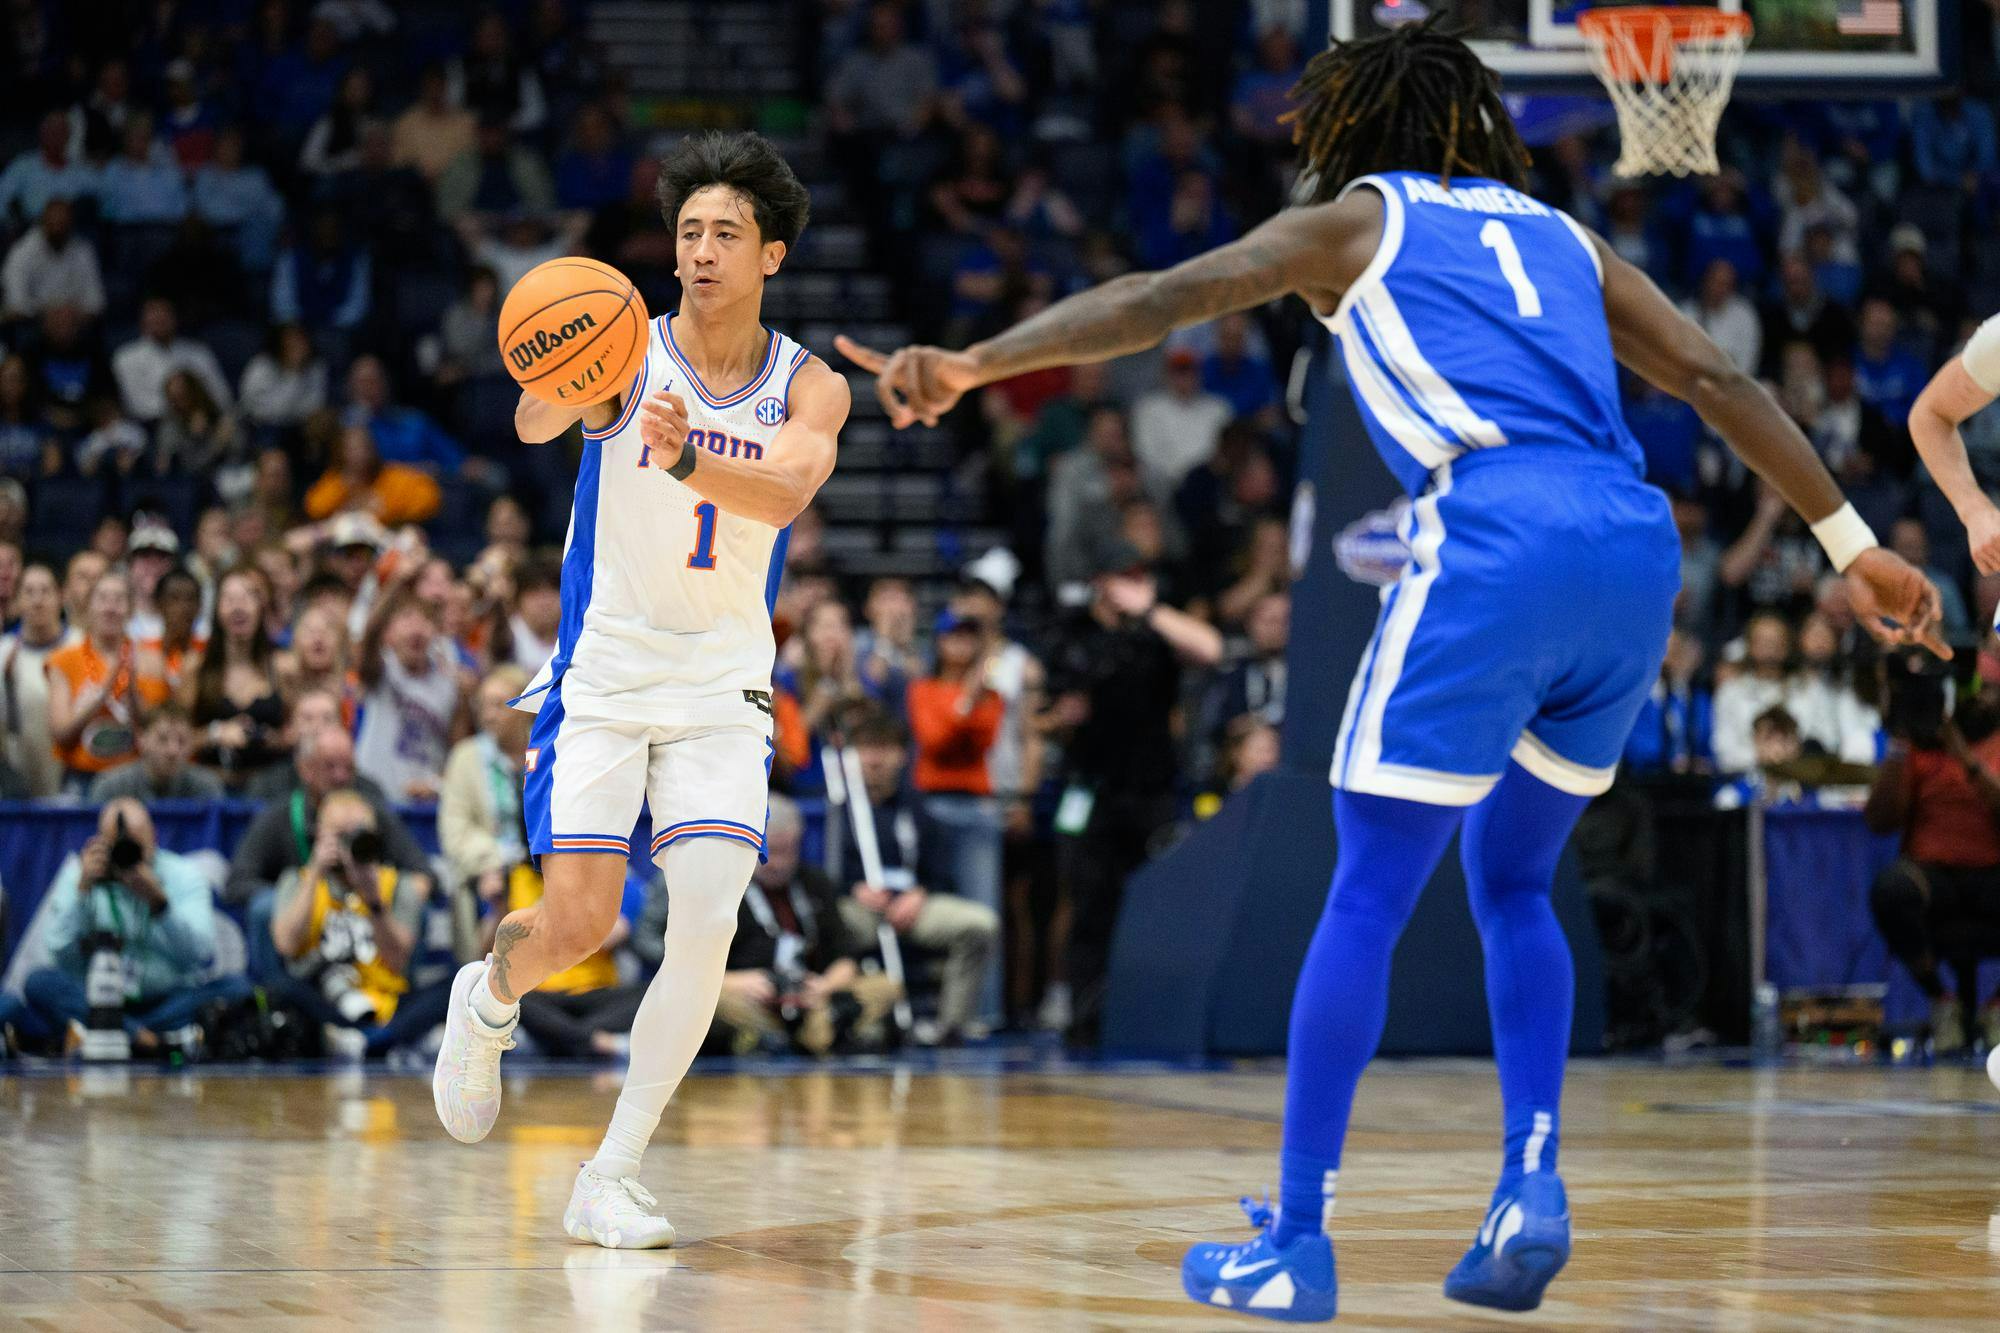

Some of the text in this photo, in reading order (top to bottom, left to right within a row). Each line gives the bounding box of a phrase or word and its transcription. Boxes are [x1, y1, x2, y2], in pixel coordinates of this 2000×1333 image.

[1479, 218, 1543, 317] 1
[508, 312, 597, 372] Wilson
[556, 360, 604, 399] EVO
[757, 398, 784, 425] SEC
[687, 500, 718, 571] 1
